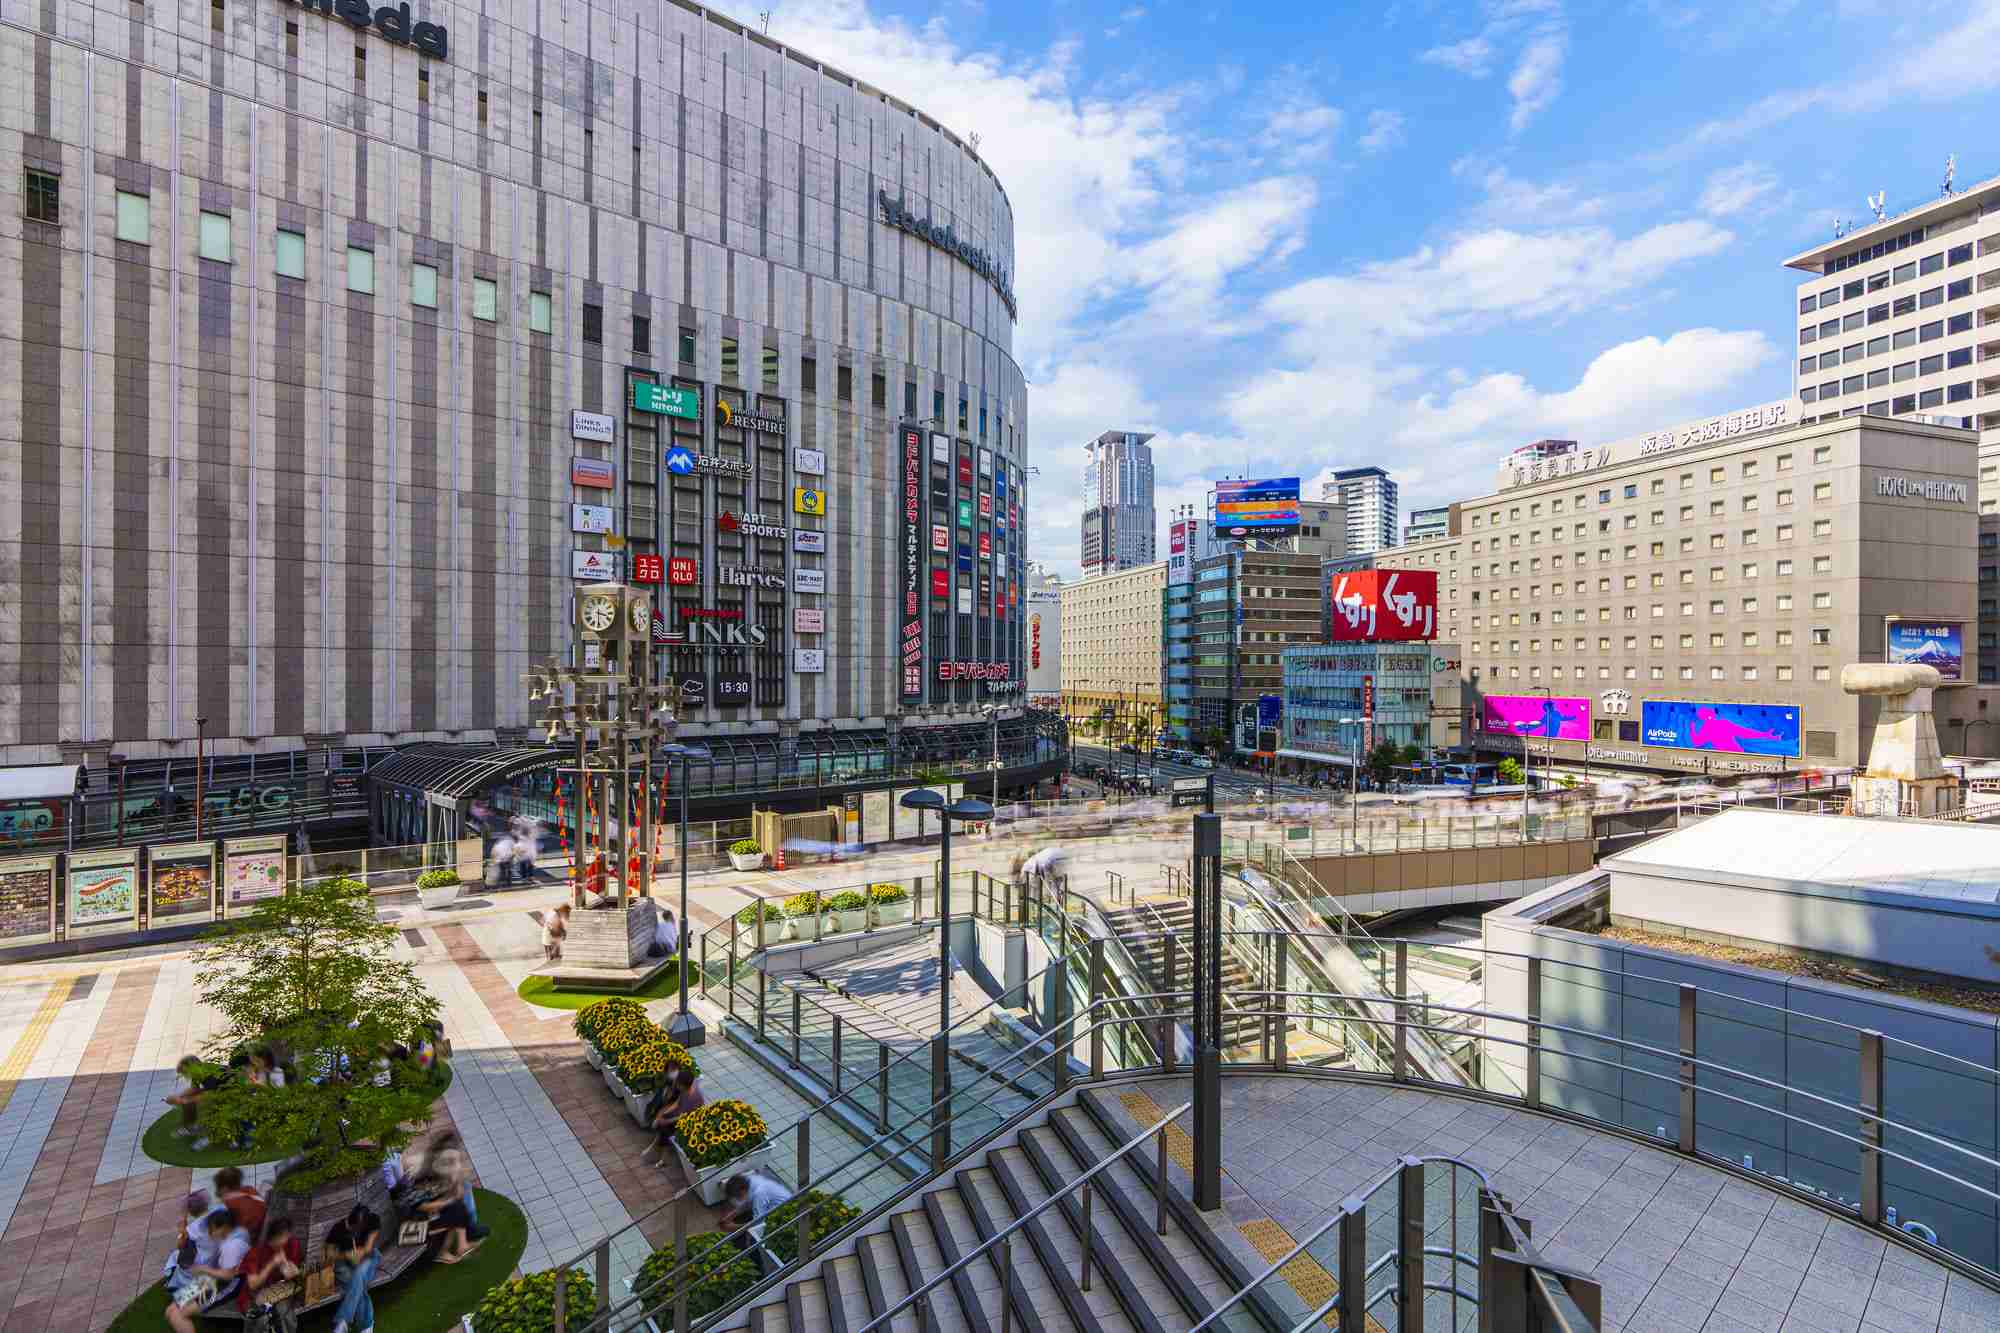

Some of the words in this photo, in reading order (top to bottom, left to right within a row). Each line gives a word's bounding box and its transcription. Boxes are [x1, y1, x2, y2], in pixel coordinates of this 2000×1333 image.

[652, 387, 683, 403] ニトリ
[652, 402, 683, 414] NITORI
[734, 415, 786, 434] RESPIRE
[1681, 402, 1787, 446] 大阪梅田駅
[1879, 476, 1907, 498] HOTEL
[741, 514, 767, 526] ART
[741, 524, 787, 539] SPORTS
[671, 559, 692, 572] UNI
[671, 570, 694, 582] QLO
[719, 566, 785, 588] Harves
[1335, 576, 1376, 636] くすり
[1382, 573, 1432, 636] くすり
[719, 682, 748, 694] 15:30
[1647, 729, 1677, 739] AirPods
